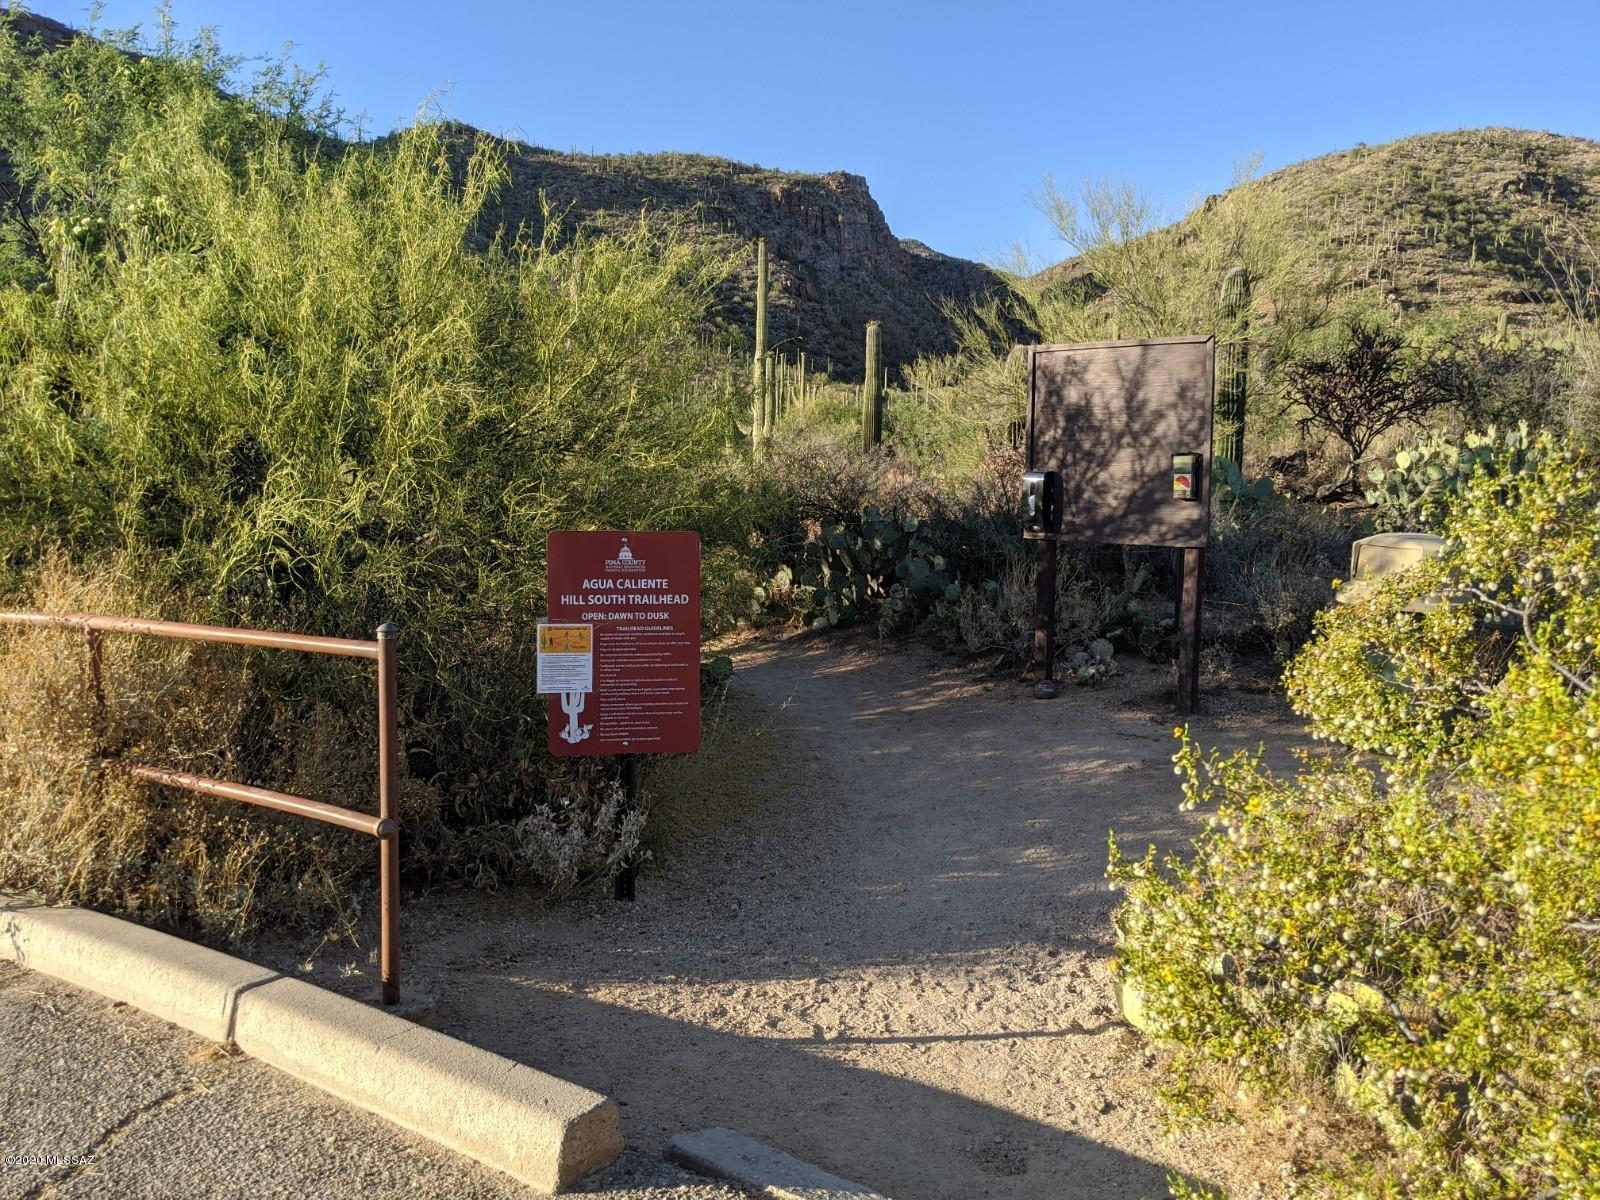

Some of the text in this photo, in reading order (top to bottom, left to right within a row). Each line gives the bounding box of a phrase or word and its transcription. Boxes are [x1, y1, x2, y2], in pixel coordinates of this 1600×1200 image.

[582, 579, 669, 589] AGUA CALIENTE
[561, 594, 689, 605] HILL SOUTH TRAILHEAD
[581, 612, 670, 621] OPEN: DAWN TO DUSK
